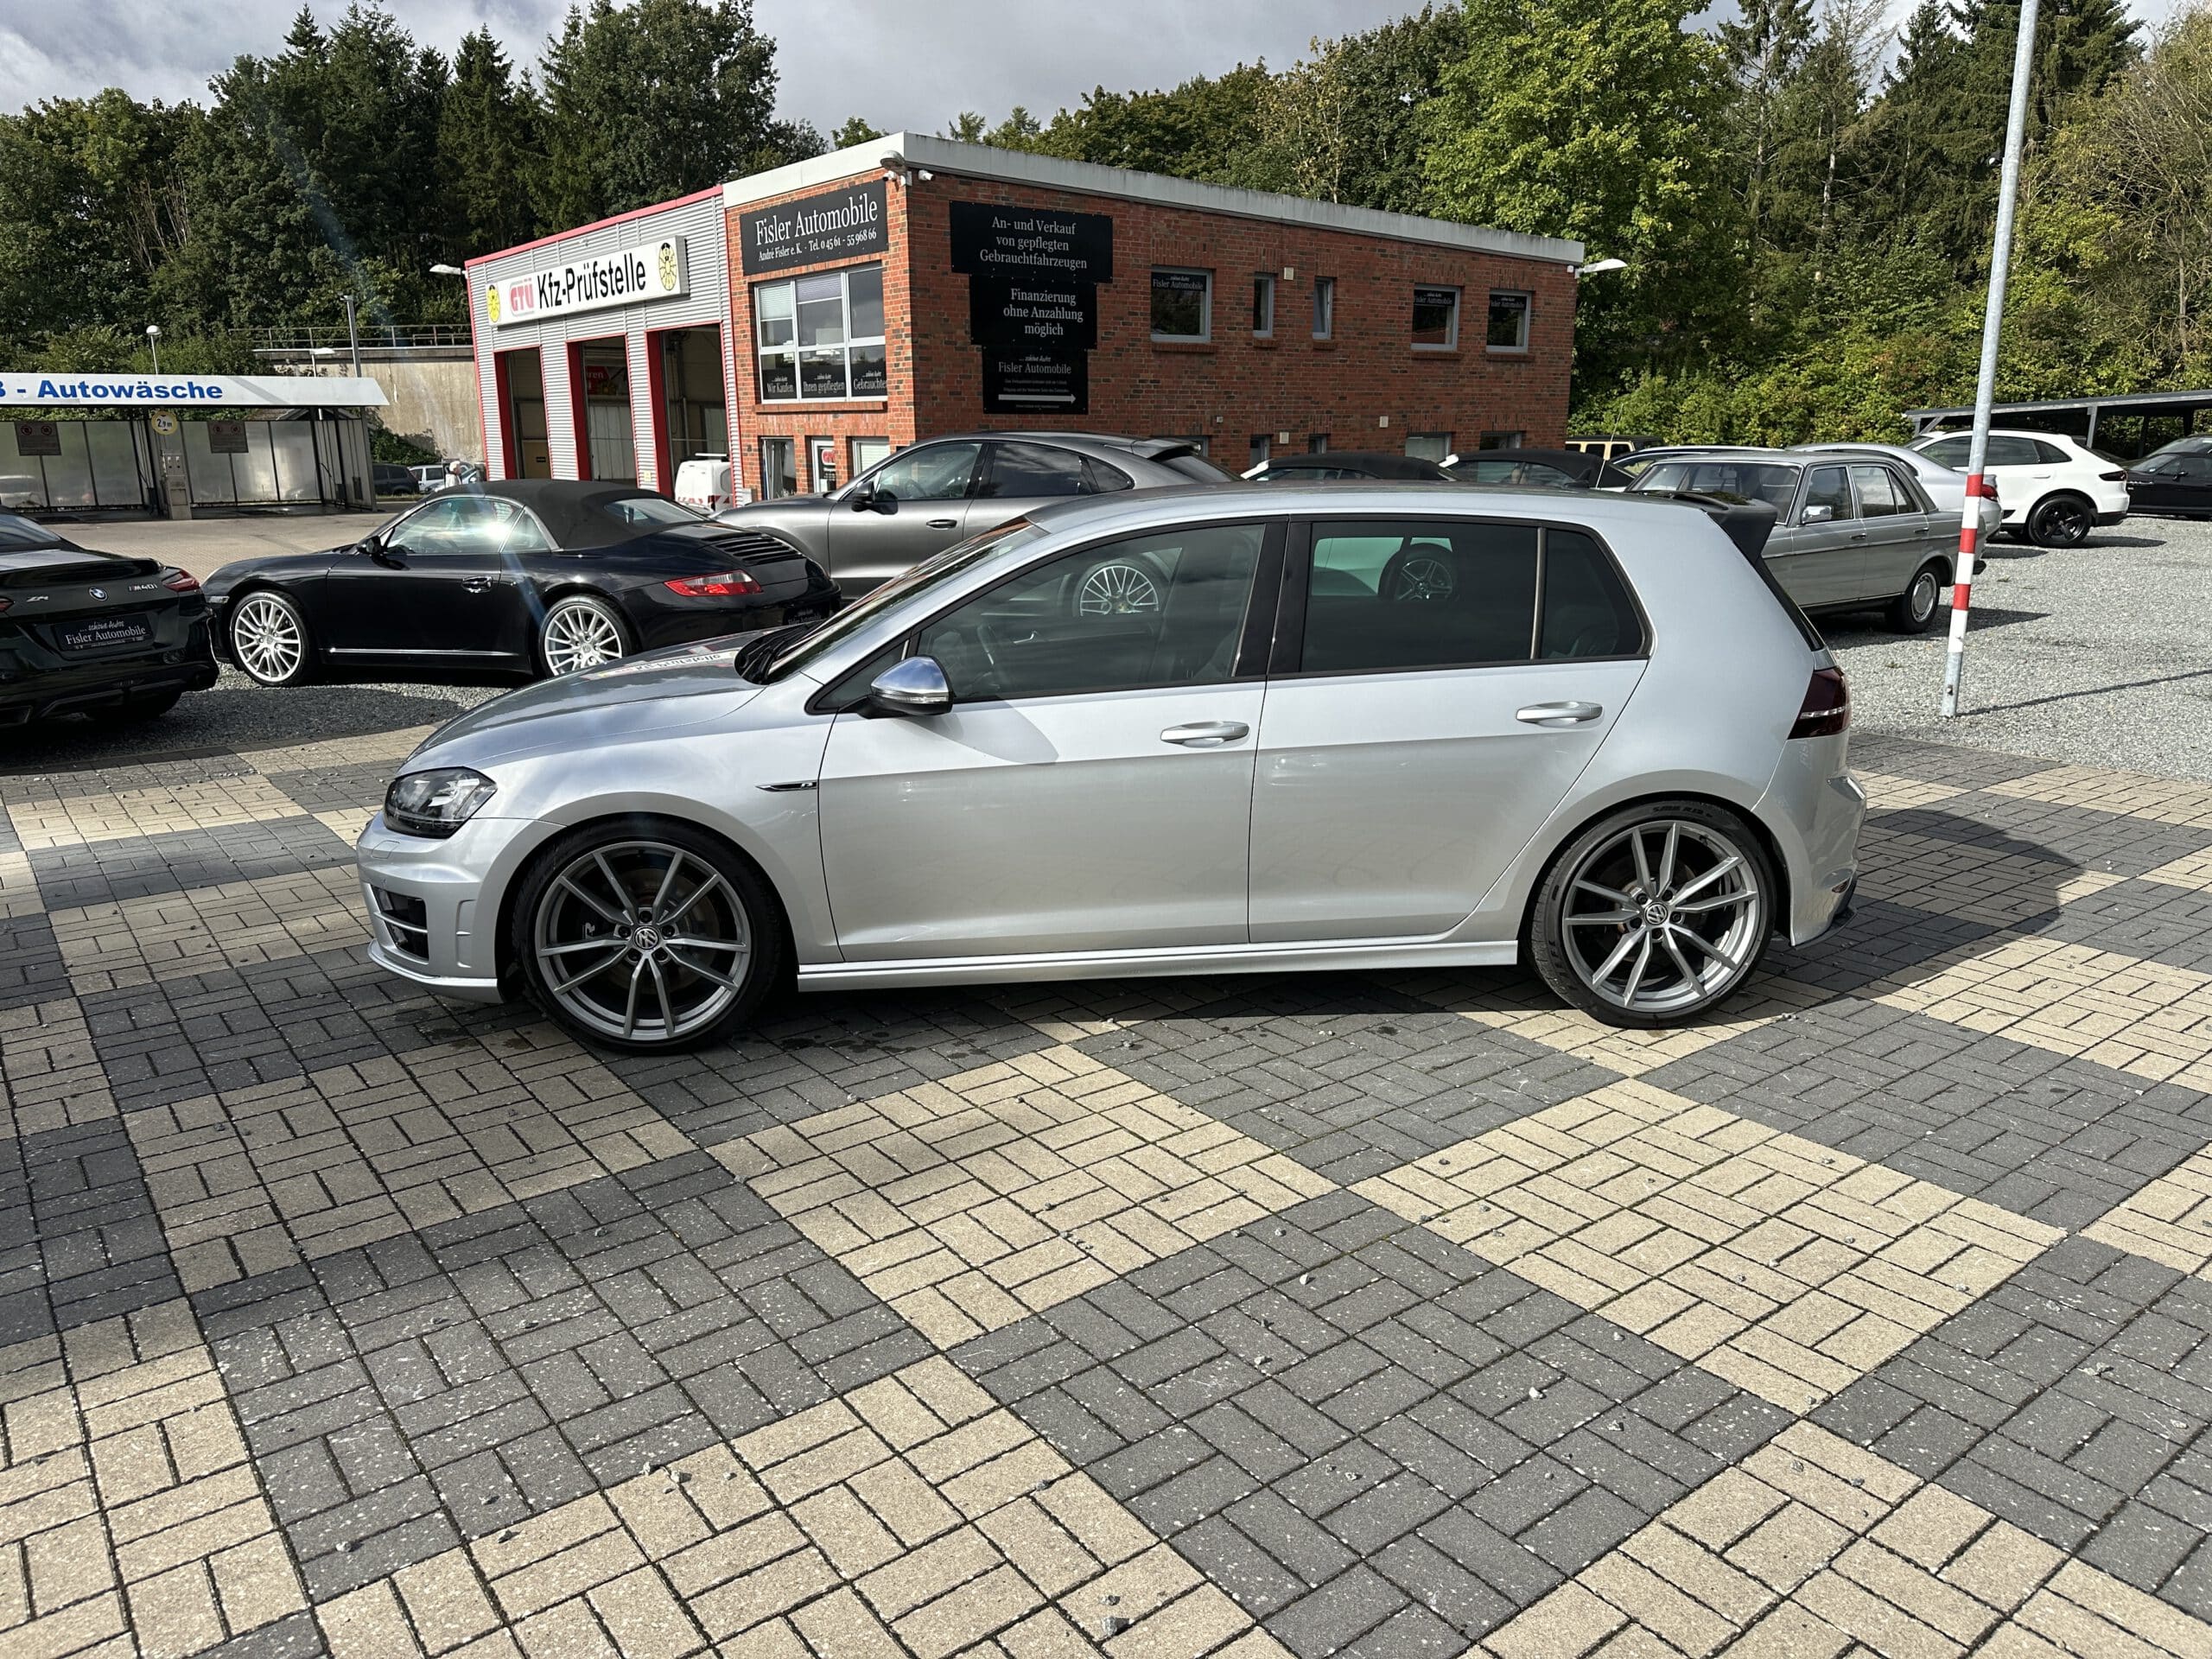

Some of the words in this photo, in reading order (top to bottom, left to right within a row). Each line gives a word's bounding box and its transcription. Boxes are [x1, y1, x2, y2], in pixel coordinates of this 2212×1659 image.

[755, 215, 791, 245] Fisler
[795, 193, 878, 238] Automobile
[992, 216, 1011, 228] An-
[1014, 219, 1033, 231] und
[1036, 220, 1077, 235] Verkauf
[759, 248, 774, 262] André
[775, 245, 790, 257] Fisler
[809, 238, 819, 251] Tel.
[996, 236, 1015, 246] von
[1018, 236, 1069, 252] gepflegten
[980, 249, 1087, 270] Gebrauchtfahrzeugen
[511, 277, 534, 311] GTÜ
[537, 253, 646, 309] Kfz-Prüfstelle
[1011, 288, 1076, 306] Finanzierung
[1003, 304, 1028, 317] ohne
[1031, 306, 1084, 322] Anzahlung
[1025, 321, 1064, 338] möglich
[998, 361, 1022, 373] Fisler
[1025, 363, 1071, 374] Automobile
[38, 380, 223, 398] Autowäsche
[65, 631, 92, 645] Fisler
[95, 626, 146, 642] Automobile
